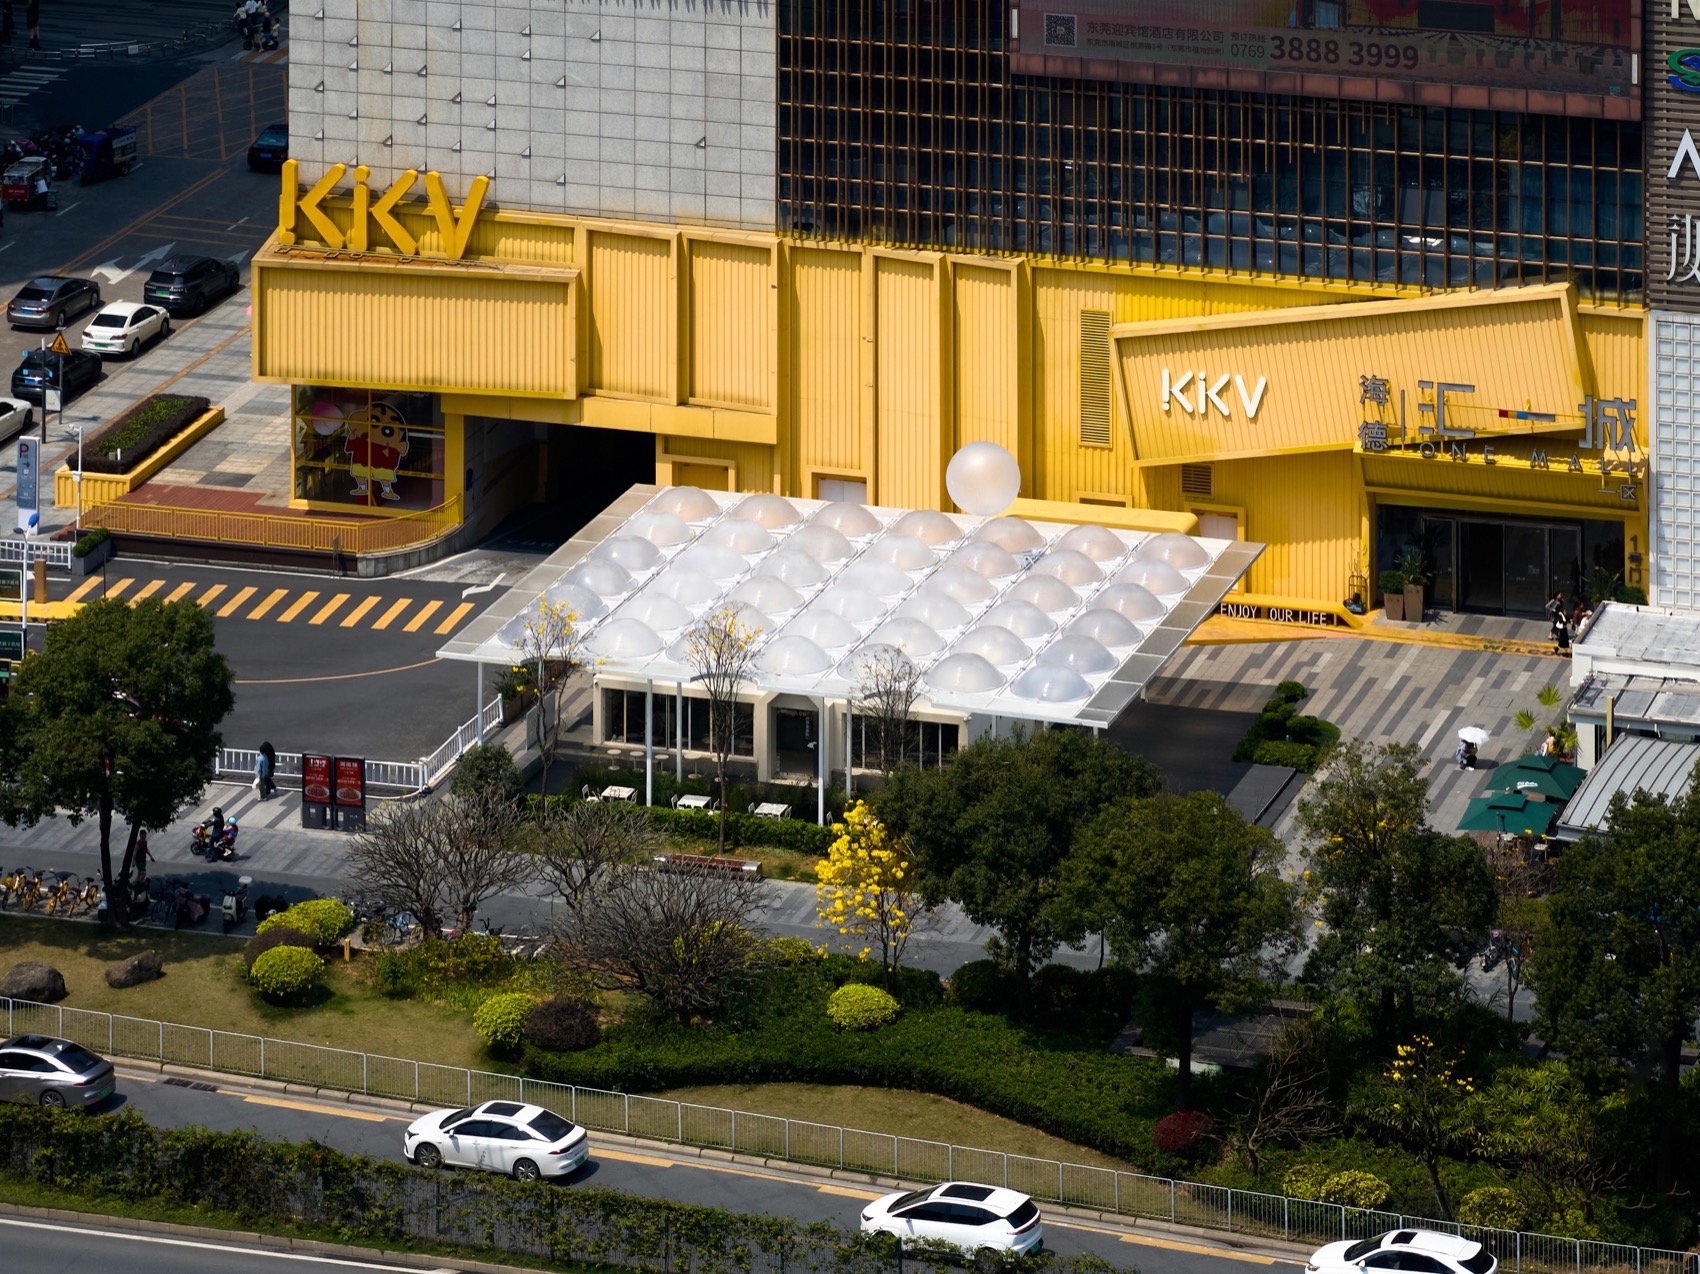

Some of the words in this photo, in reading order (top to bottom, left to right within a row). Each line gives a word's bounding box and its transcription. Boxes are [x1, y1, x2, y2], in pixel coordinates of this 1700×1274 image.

[1087, 21, 1225, 43] 东莞迎宾馆酒店有限公司
[1230, 43, 1265, 59] 0769
[1270, 35, 1340, 64] 3888
[1348, 41, 1419, 70] 3999
[1358, 374, 1389, 451] 海德
[1417, 380, 1637, 452] 汇一城
[1419, 441, 1496, 465] ONE
[1530, 449, 1639, 477] MALL
[1597, 483, 1637, 501] 一区
[1220, 603, 1258, 619] ENJOY
[1269, 607, 1294, 623] OUR
[1298, 610, 1327, 626] LIFE
